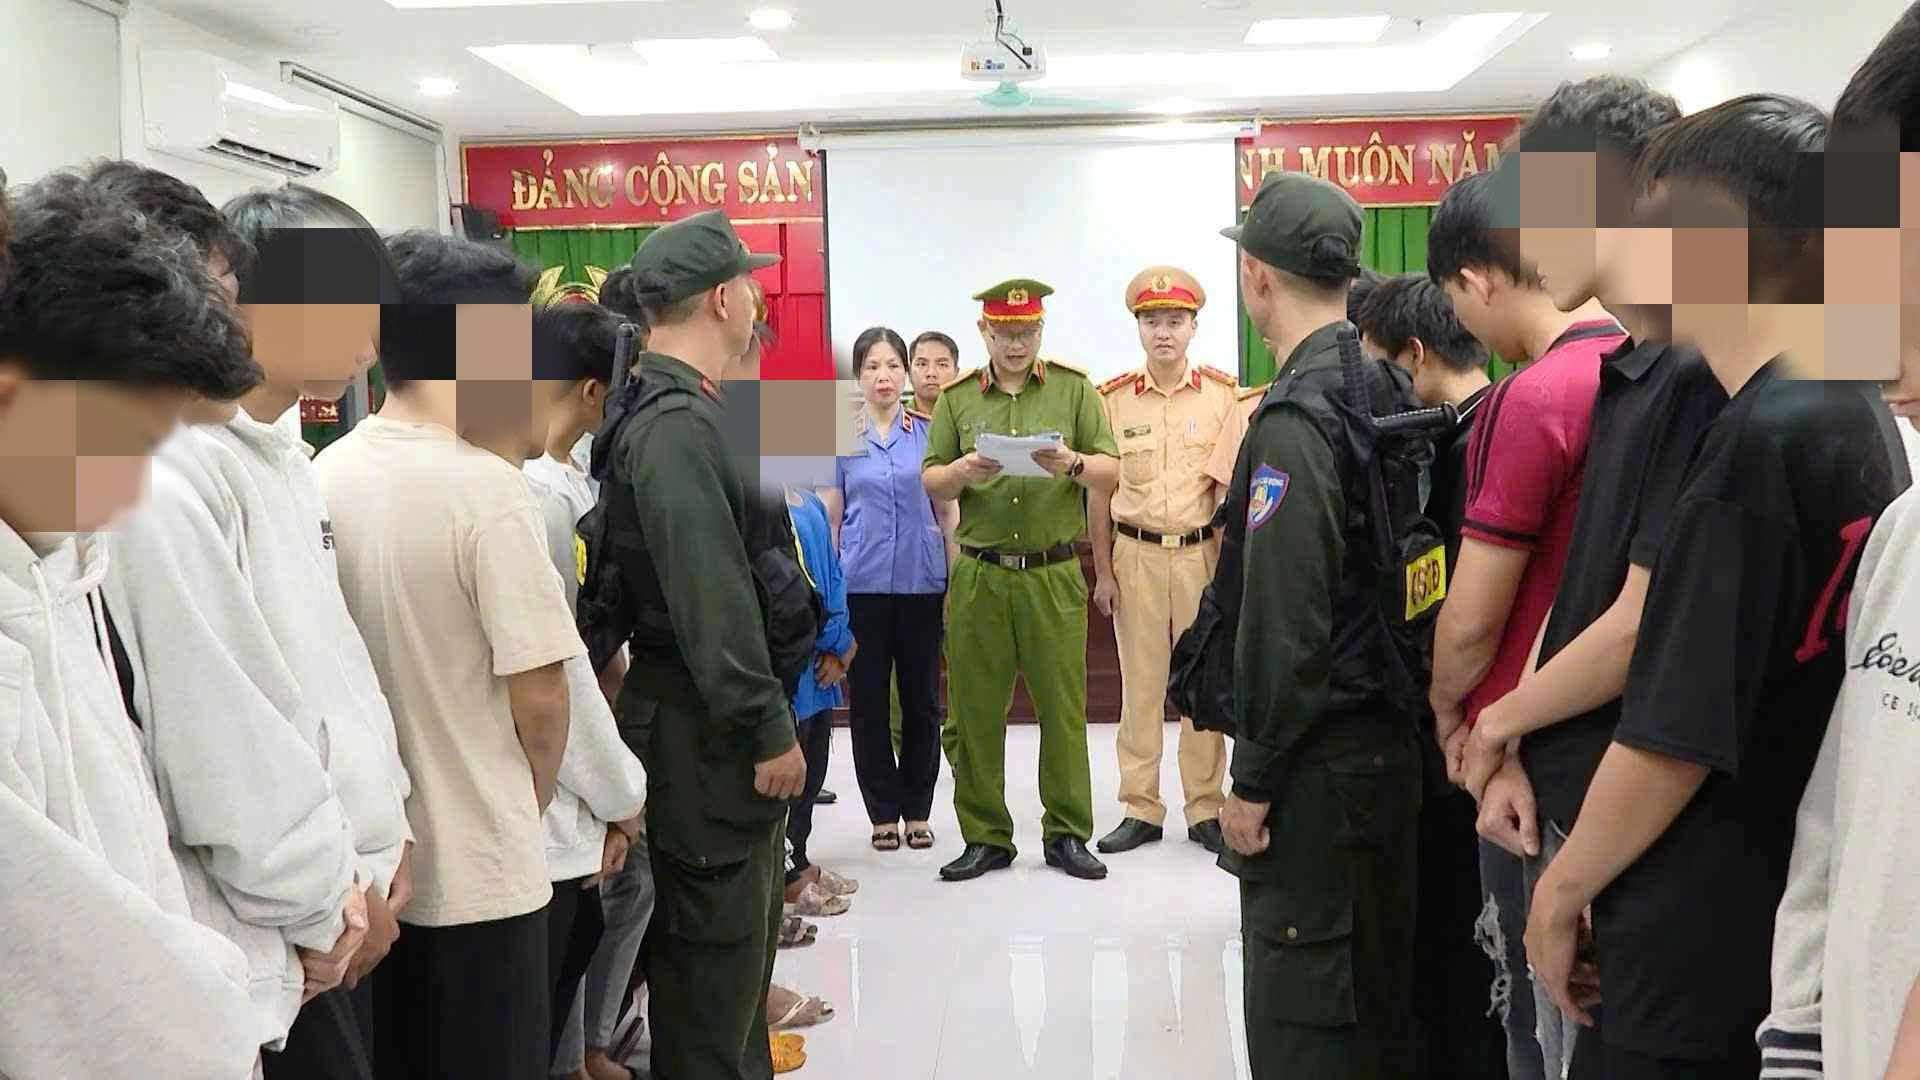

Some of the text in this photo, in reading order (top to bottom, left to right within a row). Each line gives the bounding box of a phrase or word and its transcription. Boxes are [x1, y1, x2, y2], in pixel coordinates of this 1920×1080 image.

[511, 143, 814, 214] ĐẢNG CỘNG SẢN
[1298, 130, 1416, 186] MUÔN
